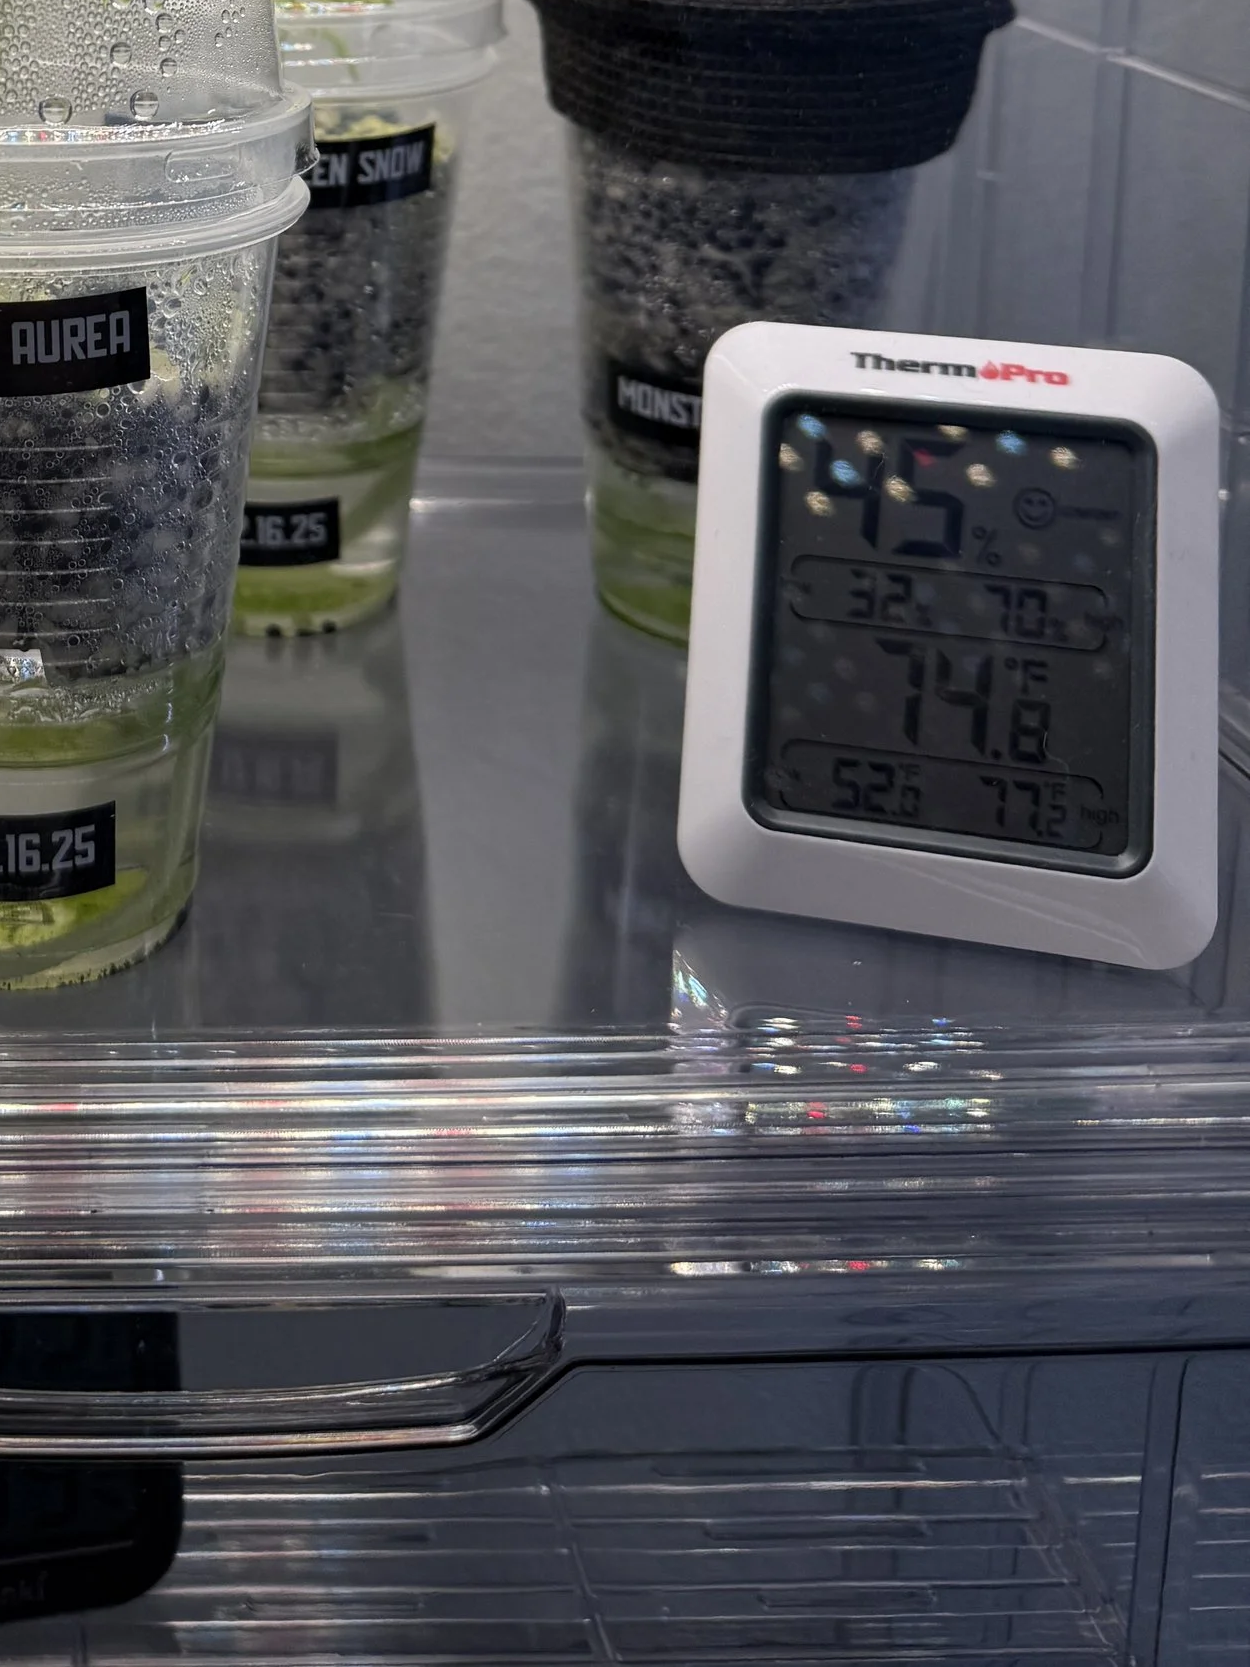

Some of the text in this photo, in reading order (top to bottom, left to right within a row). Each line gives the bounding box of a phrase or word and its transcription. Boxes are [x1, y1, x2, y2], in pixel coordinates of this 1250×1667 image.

[307, 140, 425, 187] EN SNOW
[11, 310, 131, 366] AUREA
[1080, 804, 1121, 827] high
